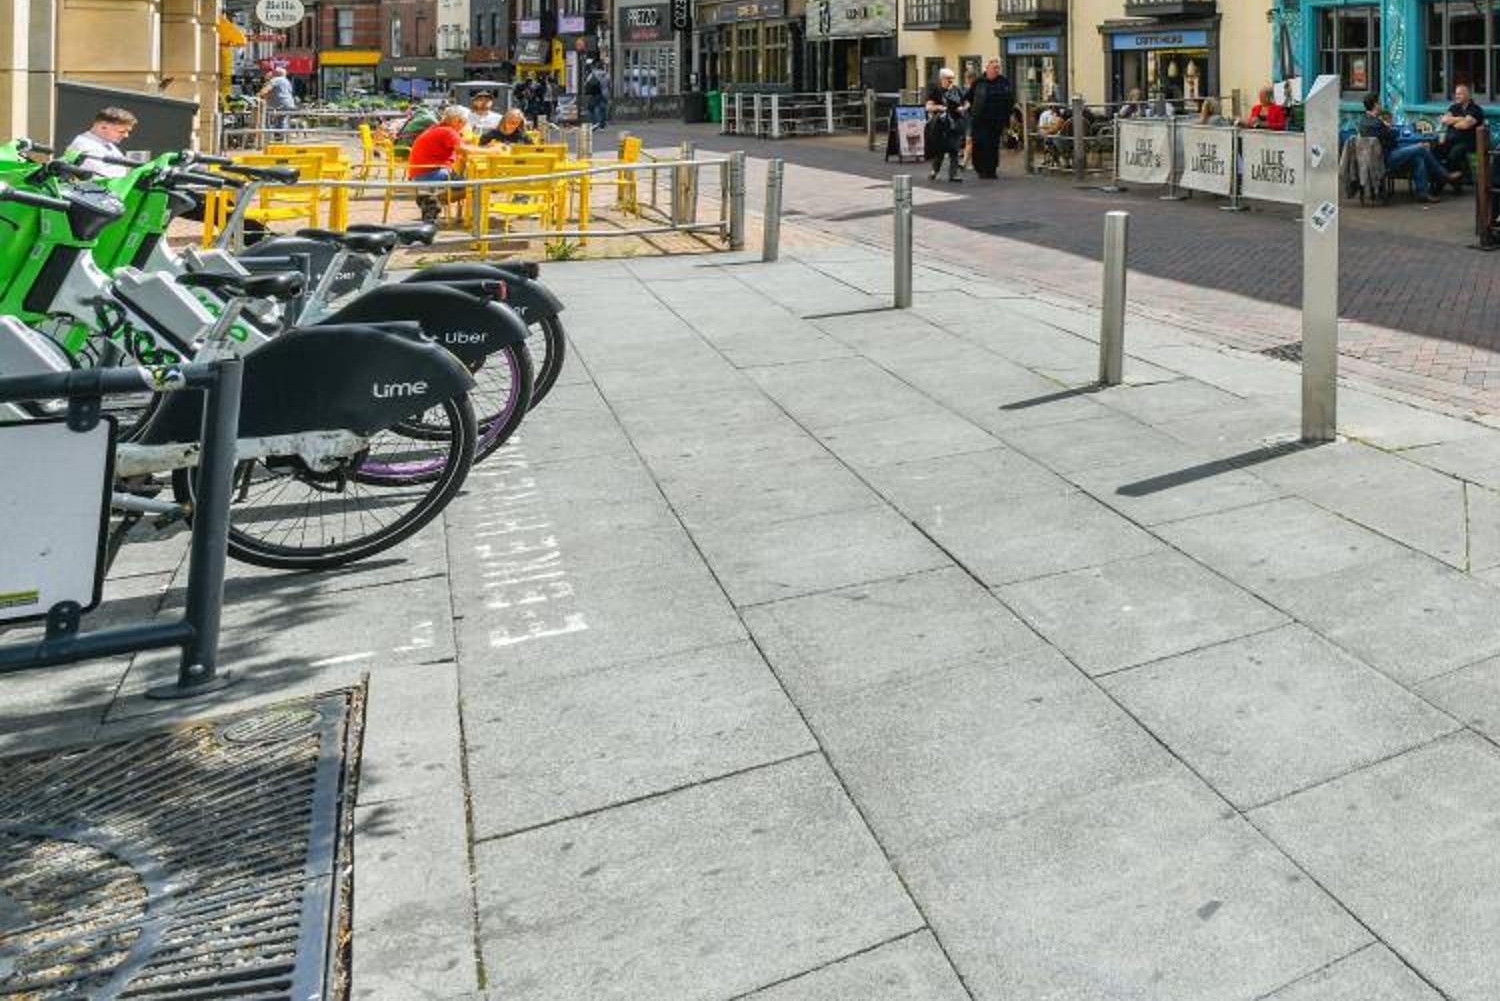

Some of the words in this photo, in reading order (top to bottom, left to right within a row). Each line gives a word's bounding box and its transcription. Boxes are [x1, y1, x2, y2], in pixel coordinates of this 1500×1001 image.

[1262, 148, 1285, 168] LILLIE
[1251, 164, 1295, 185] LANGTRY'S
[445, 332, 488, 345] Uber
[373, 380, 428, 399] Lime
